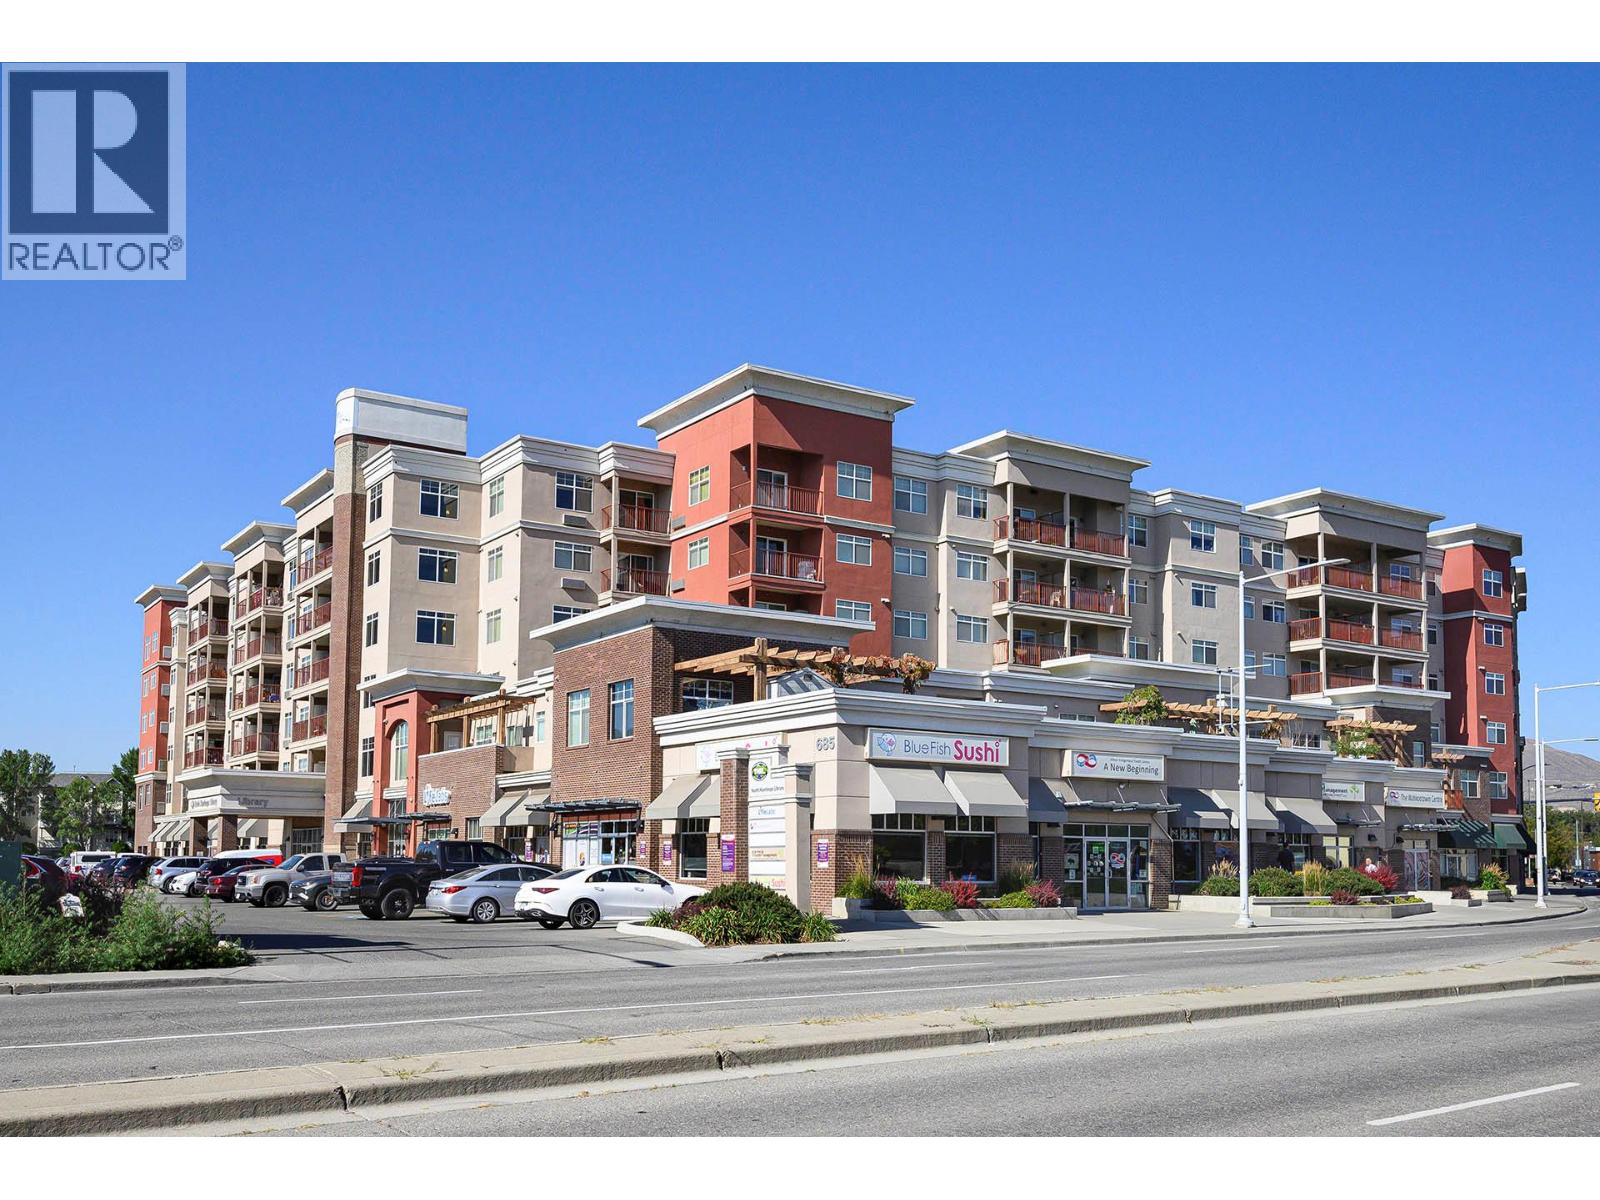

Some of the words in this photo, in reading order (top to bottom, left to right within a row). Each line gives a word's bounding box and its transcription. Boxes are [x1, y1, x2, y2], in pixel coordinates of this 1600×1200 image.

[816, 737, 836, 751] 685
[953, 739, 1000, 763] Sushi
[1104, 763, 1109, 771] A
[1110, 763, 1126, 772] New
[1127, 764, 1158, 775] Beginning
[238, 797, 269, 808] Library
